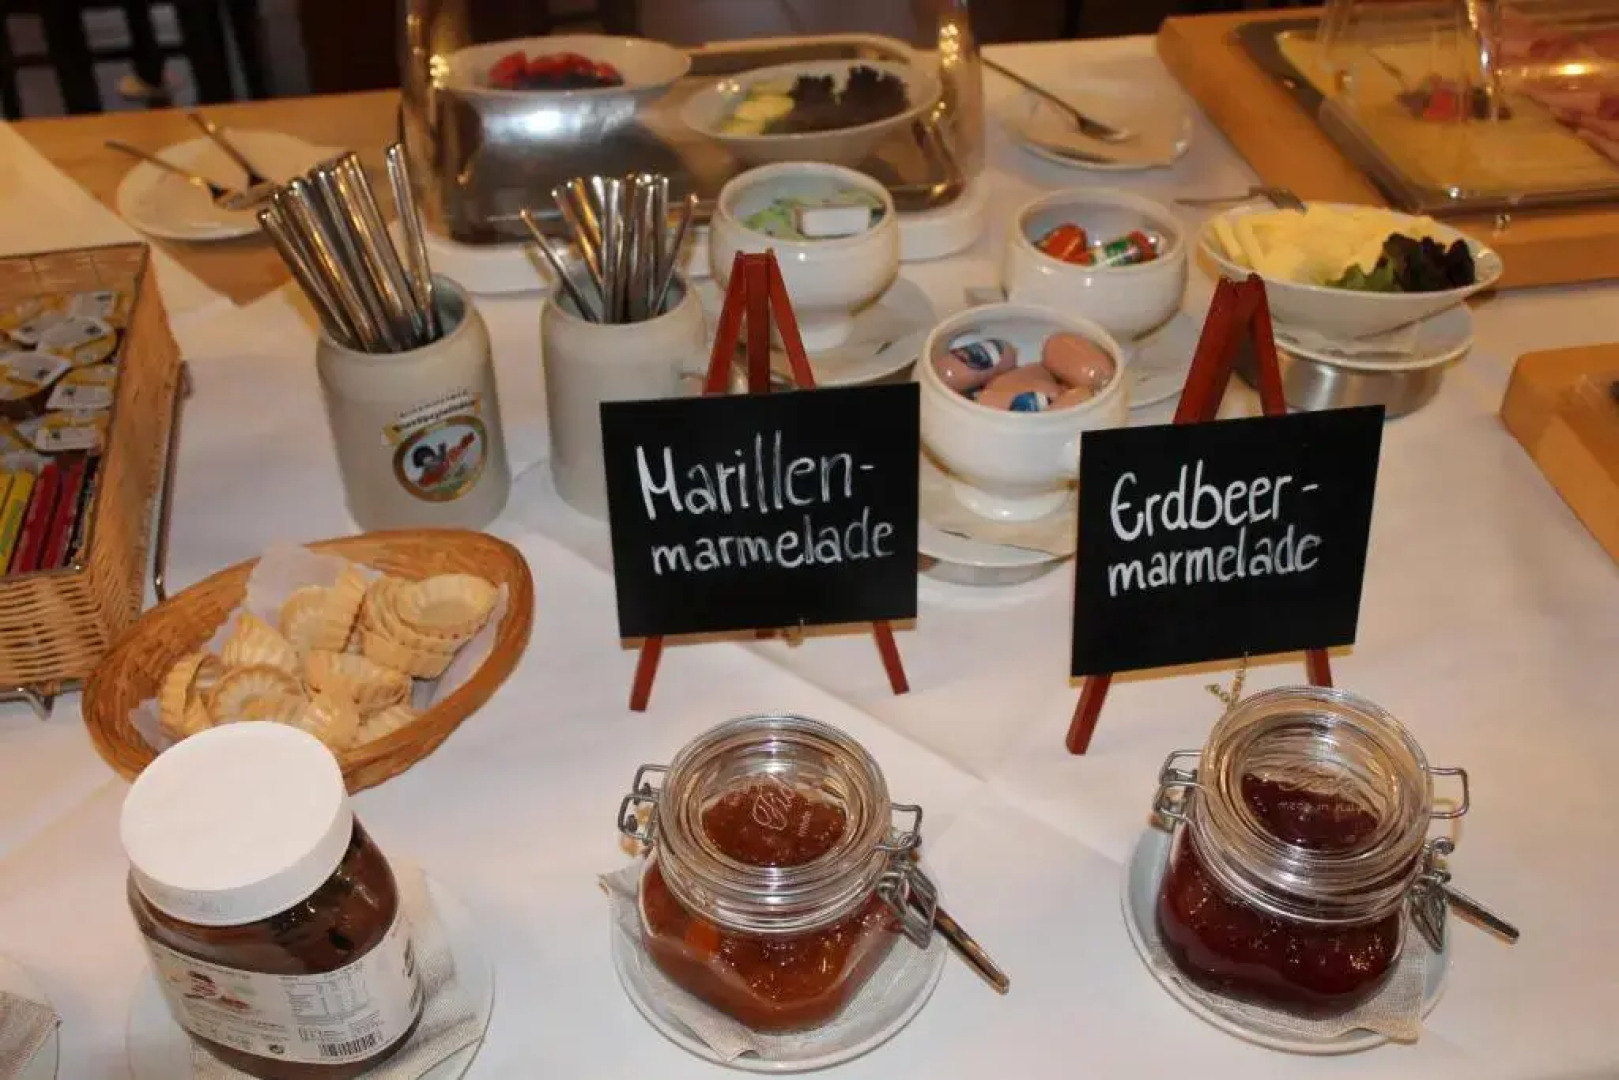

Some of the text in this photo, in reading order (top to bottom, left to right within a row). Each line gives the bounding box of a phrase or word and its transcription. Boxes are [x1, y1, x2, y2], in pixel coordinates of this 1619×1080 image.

[635, 429, 877, 521] Marillen-
[1109, 459, 1320, 542] Erdbeer-
[650, 505, 895, 577] marmelade
[1107, 523, 1323, 597] marmelade
